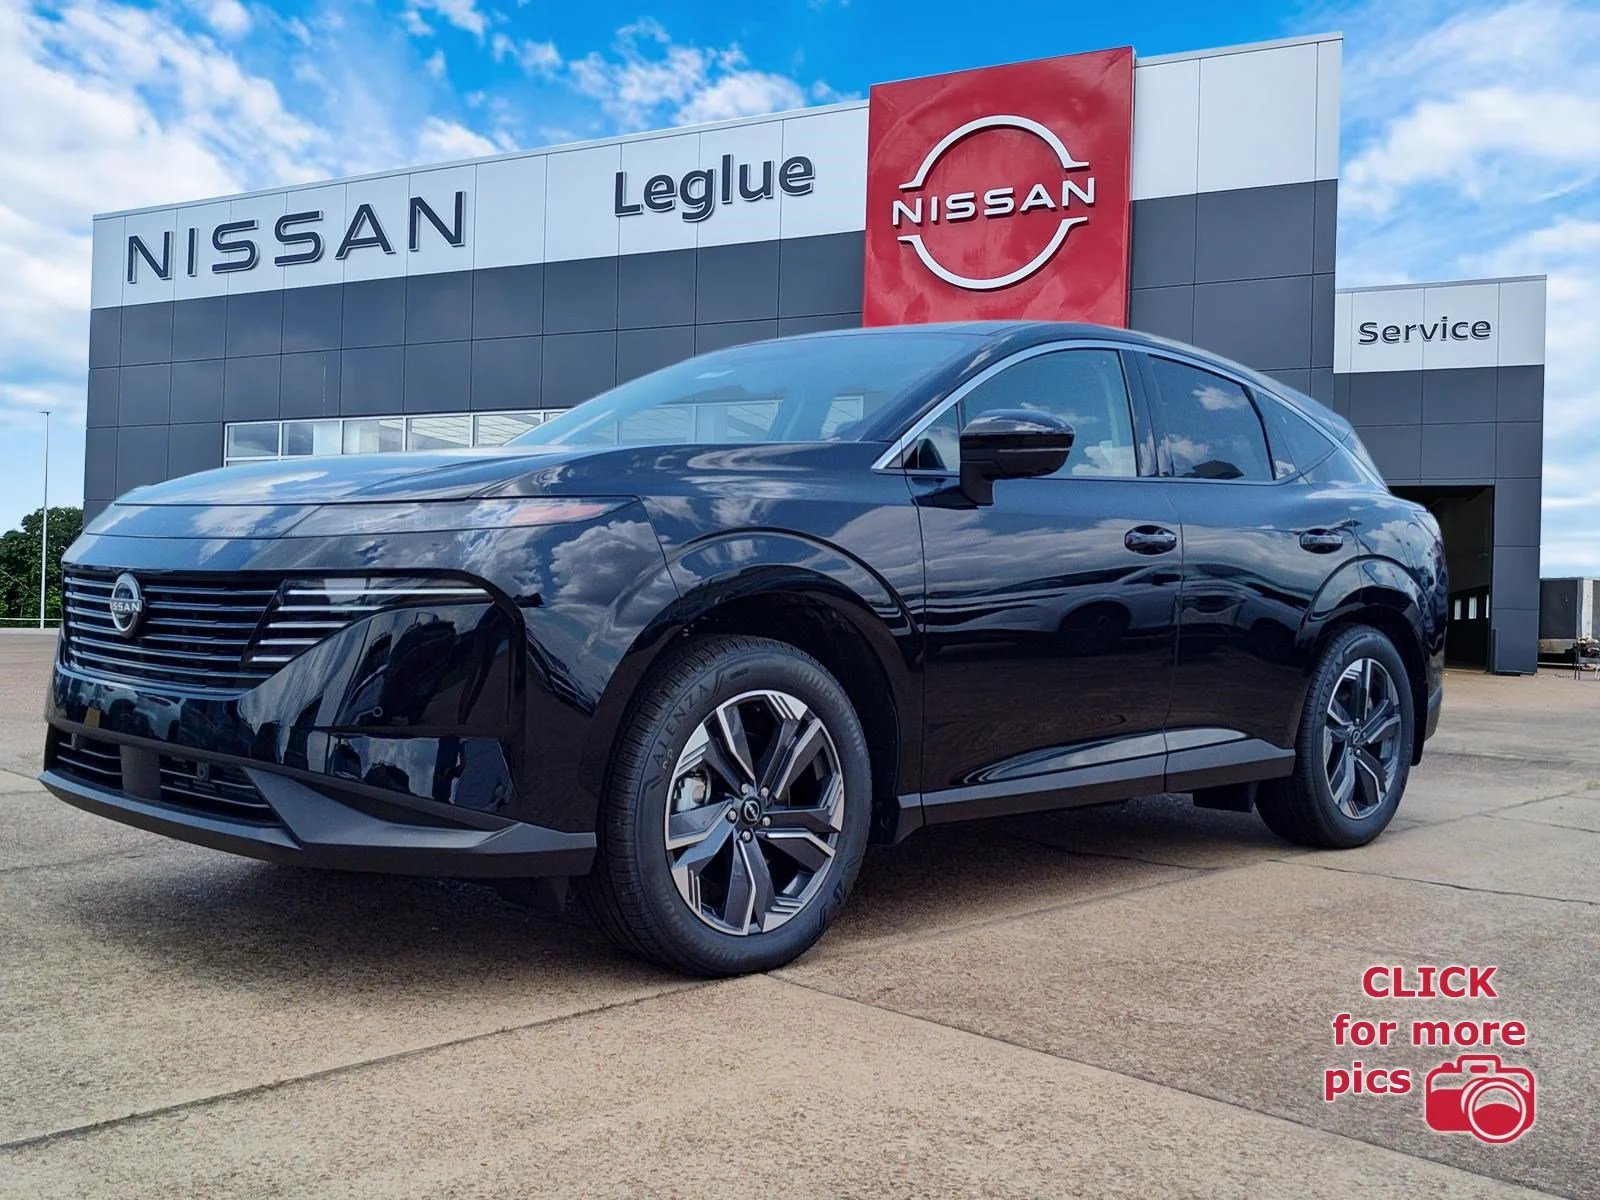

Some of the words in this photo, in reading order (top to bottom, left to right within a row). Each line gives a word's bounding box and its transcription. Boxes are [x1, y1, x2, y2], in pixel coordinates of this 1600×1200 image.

[614, 153, 815, 222] Leglue
[892, 177, 1095, 226] NISSAN
[127, 190, 465, 284] NISSAN
[1358, 316, 1491, 344] Service
[110, 601, 140, 612] SSAN
[653, 683, 711, 766] ALENZA
